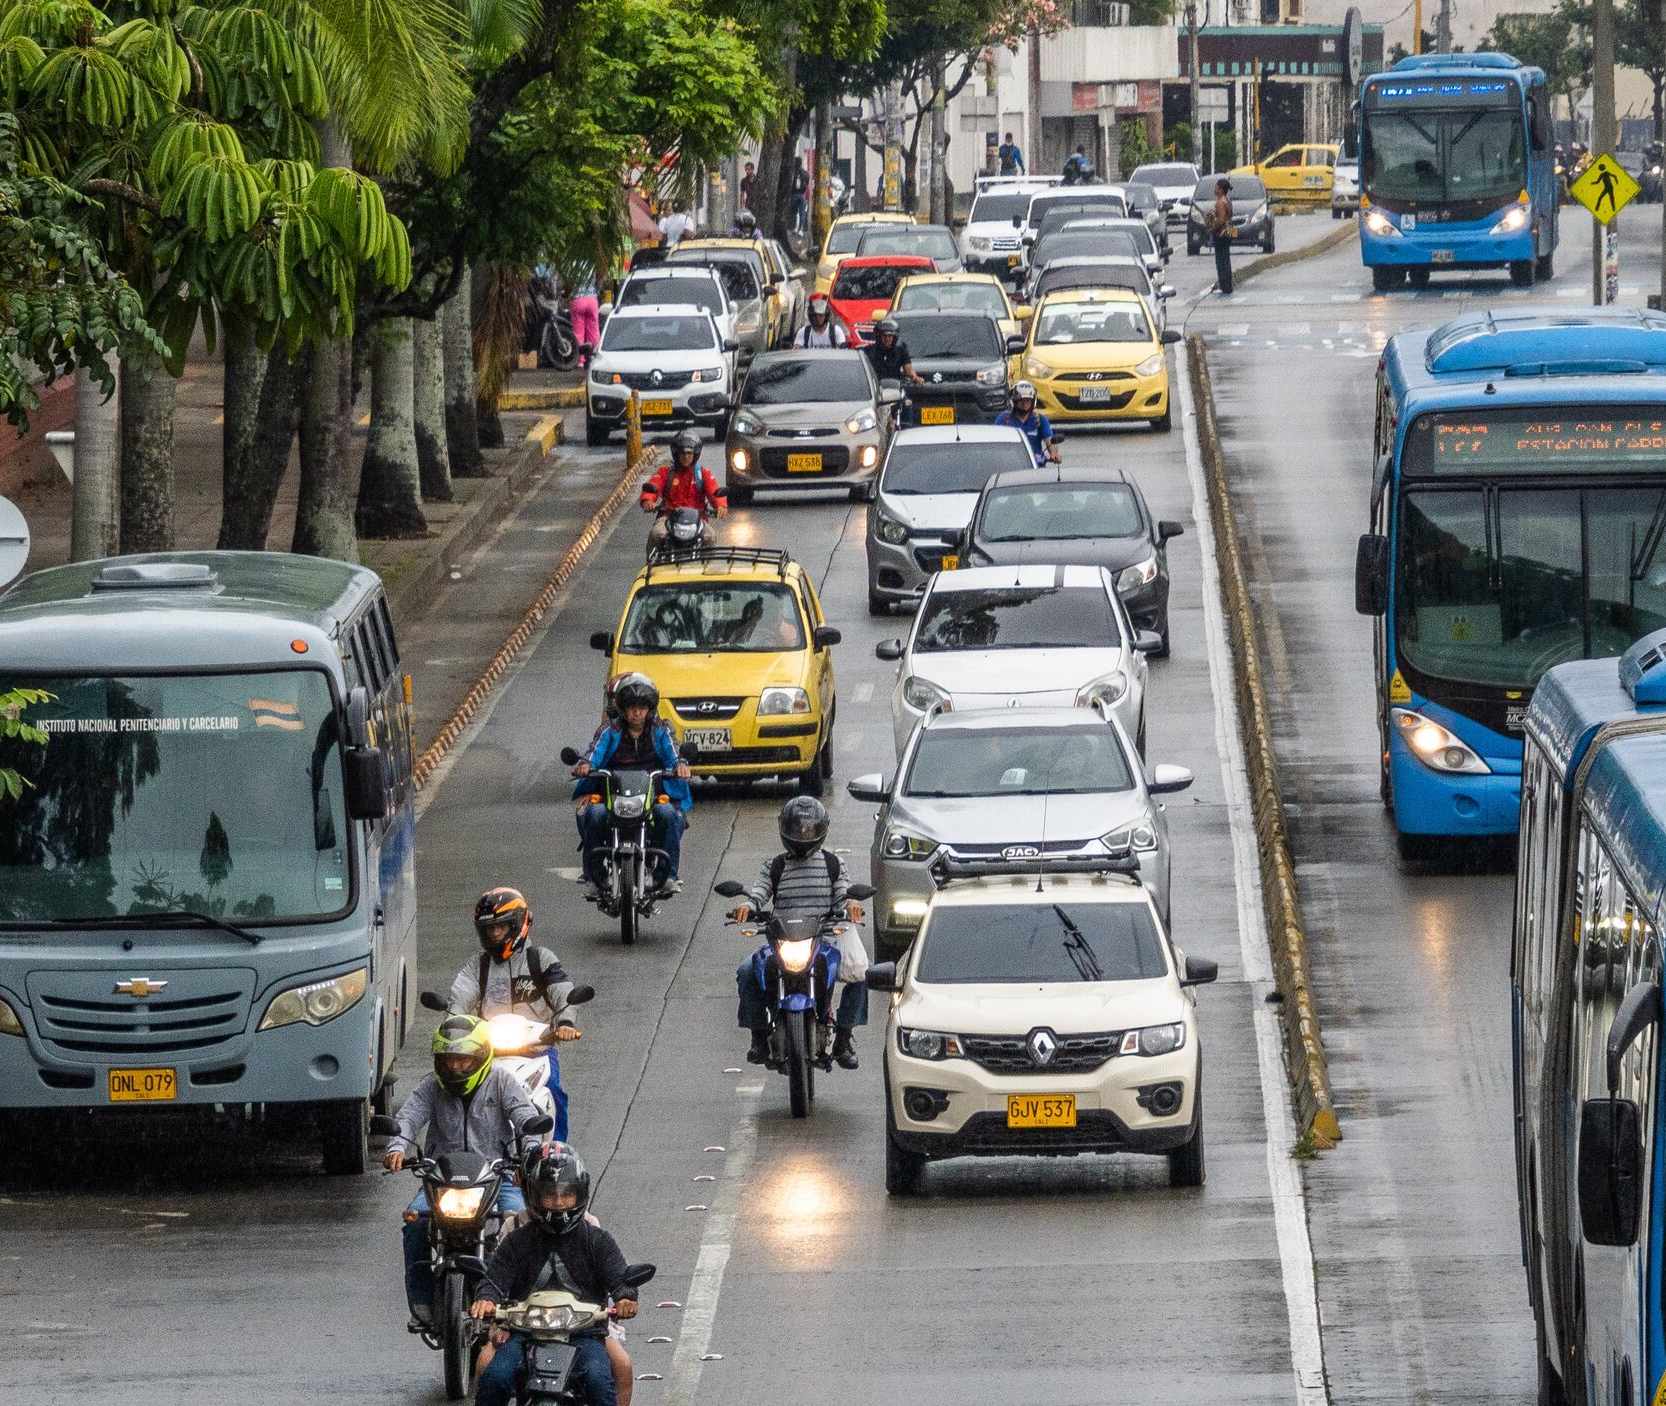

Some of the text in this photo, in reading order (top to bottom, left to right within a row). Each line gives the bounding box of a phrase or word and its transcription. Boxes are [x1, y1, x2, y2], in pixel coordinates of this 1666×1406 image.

[36, 716, 238, 732] INSTITUTO NACIONAL PENITENCIARIO Y CARCELARIO
[1007, 848, 1033, 857] JAC
[144, 1074, 173, 1092] 079
[1011, 1100, 1073, 1118] GJV 537
